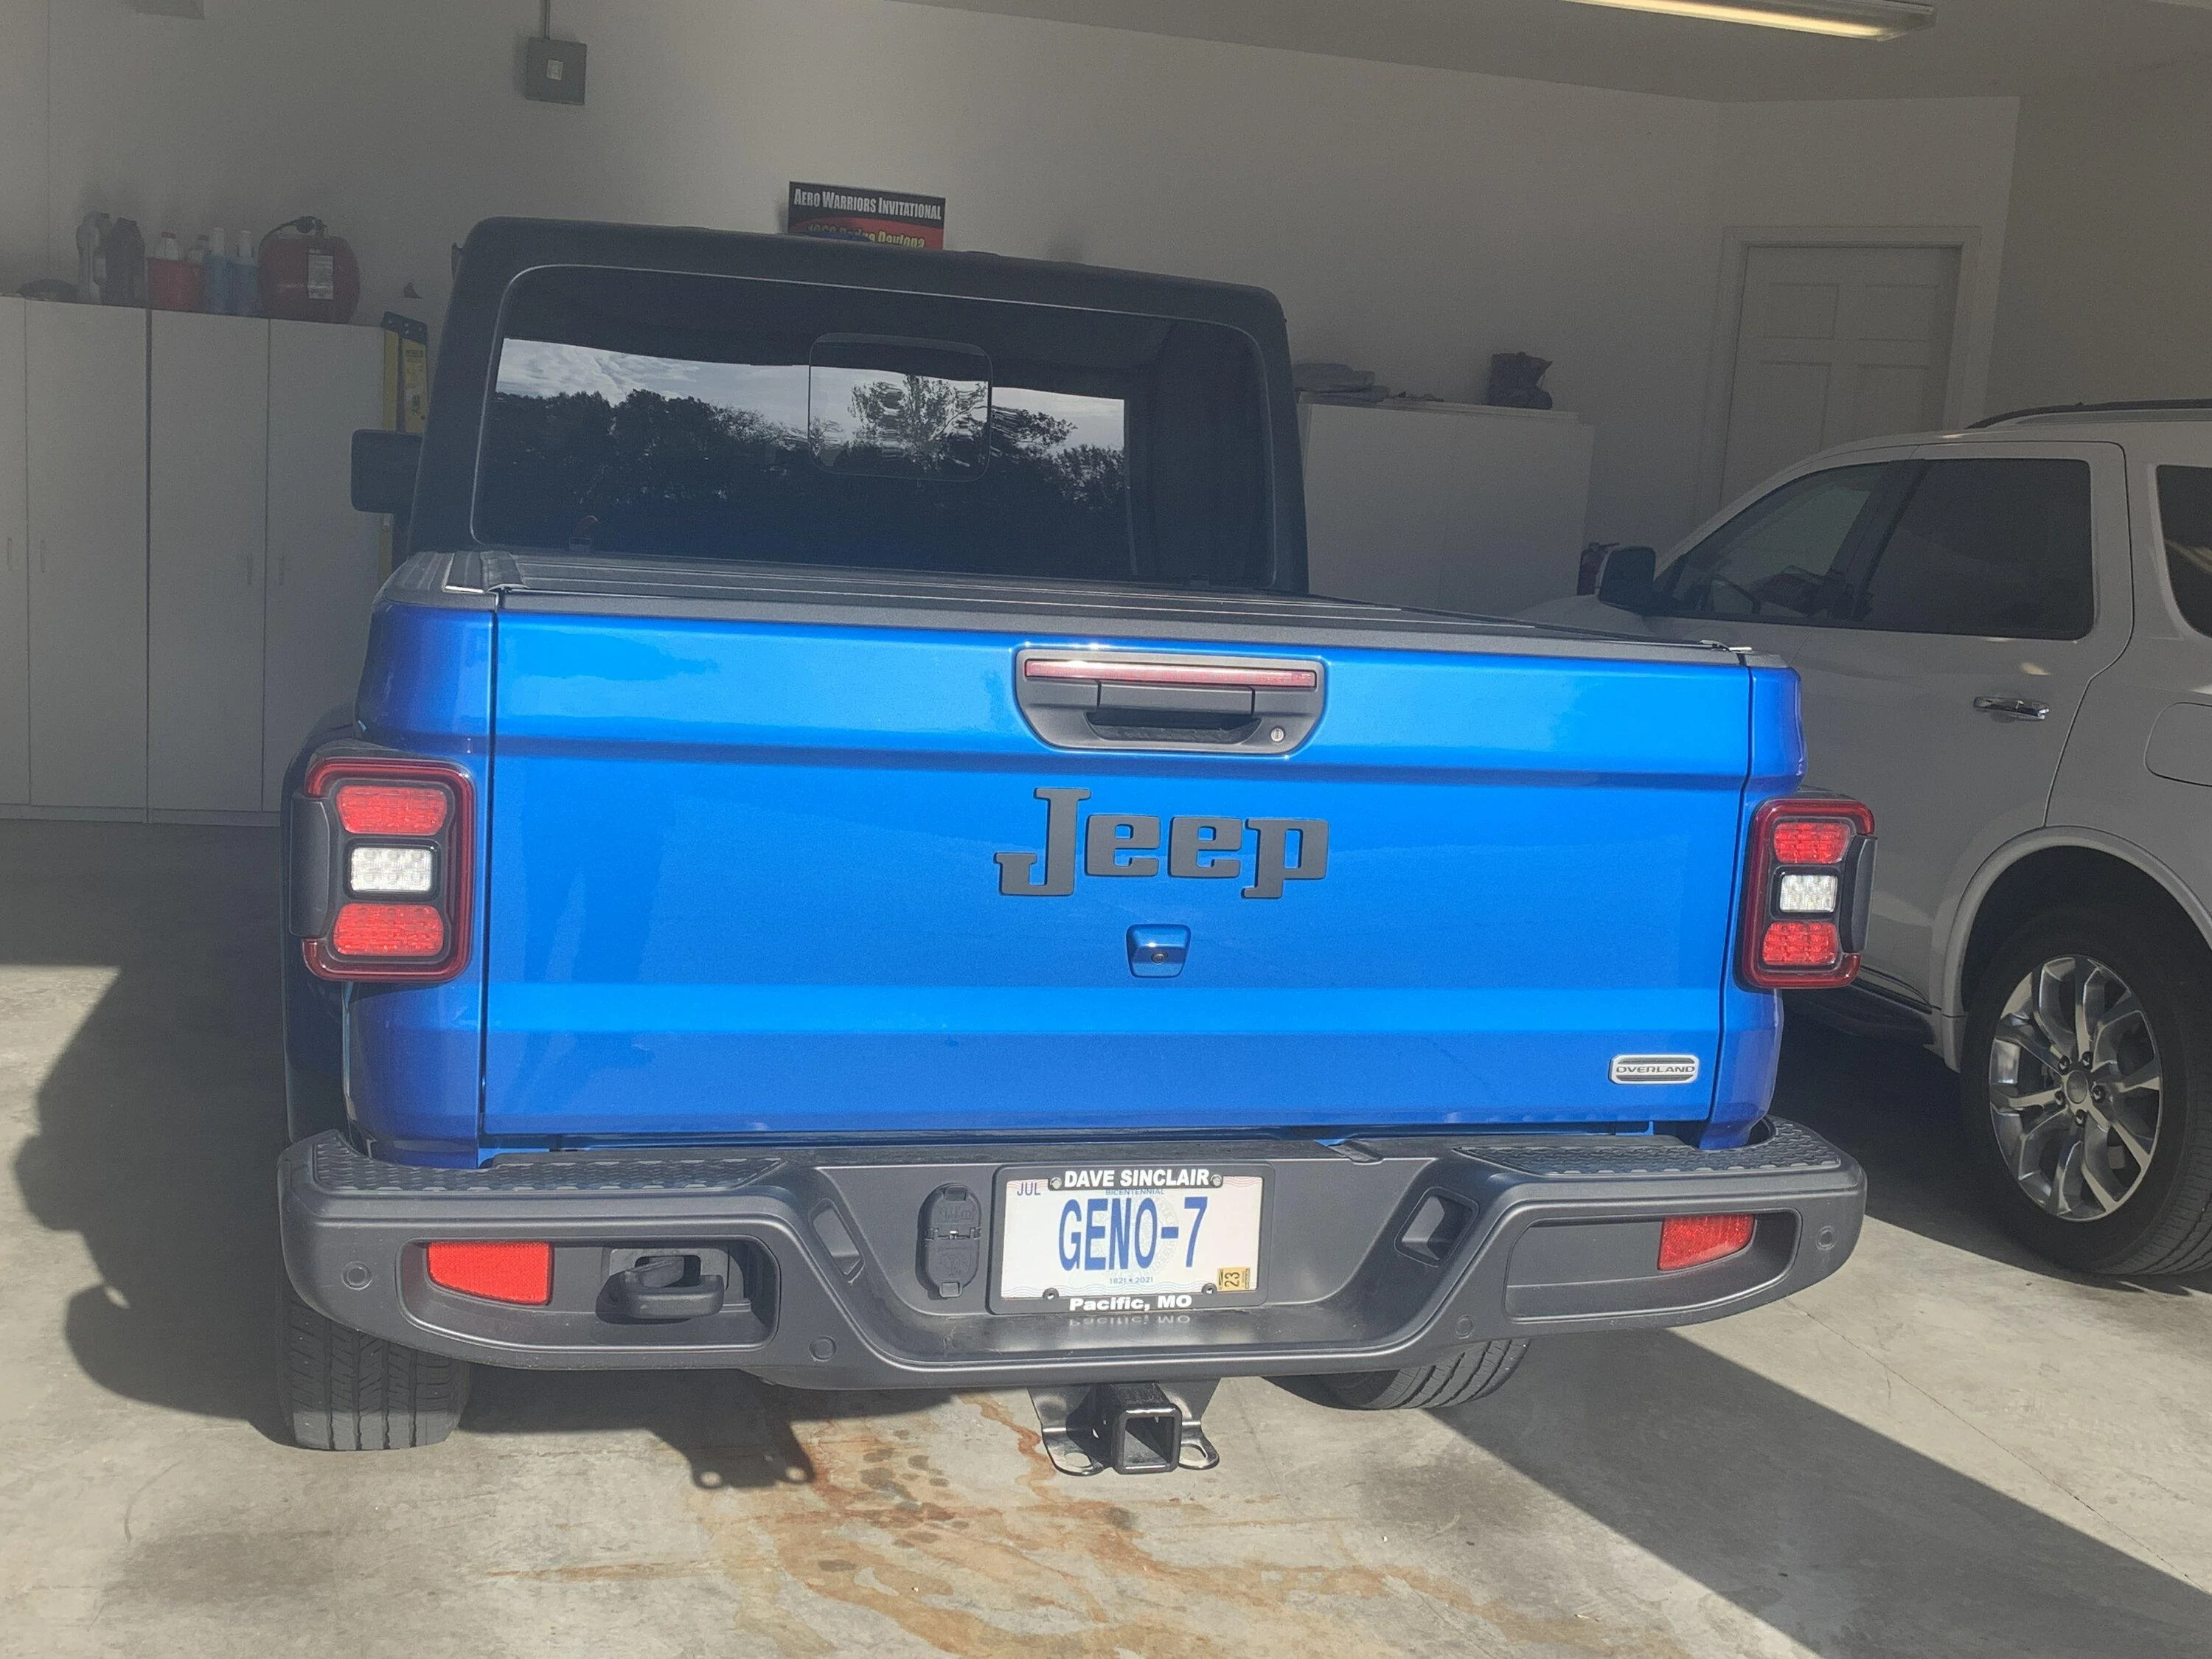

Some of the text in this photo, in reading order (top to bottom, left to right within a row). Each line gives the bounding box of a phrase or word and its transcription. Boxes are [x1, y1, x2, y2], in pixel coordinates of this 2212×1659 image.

[793, 188, 942, 220] AERO WARRIORS INVITATIONAL
[994, 787, 1329, 900] Jeep
[1615, 1065, 1695, 1074] OVERLAND
[1064, 1168, 1210, 1188] DAVE SINCLAIR
[1016, 1182, 1041, 1197] JUL
[1105, 1188, 1165, 1196] BICENTENNIAL
[1058, 1196, 1208, 1272] GENO-7
[1224, 1272, 1240, 1287] 23
[1069, 1294, 1192, 1312] Pacific, MO
